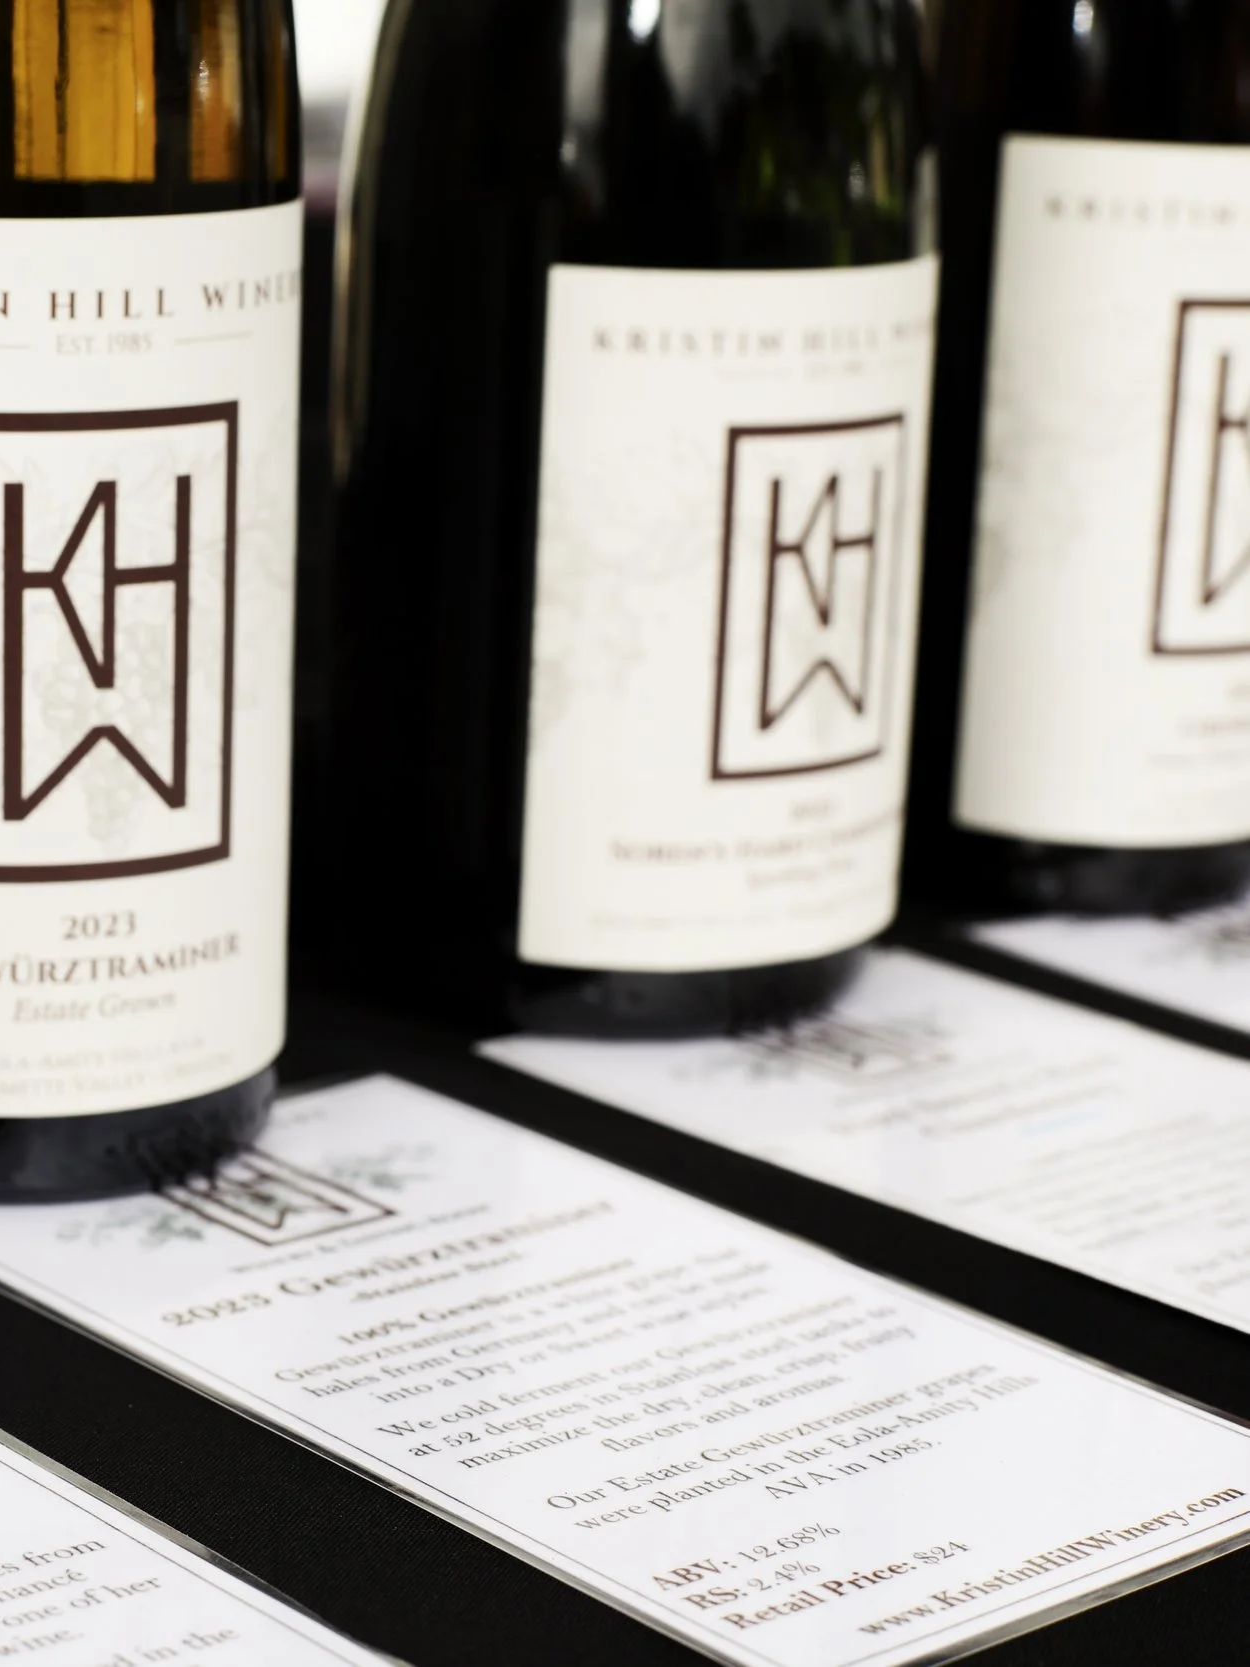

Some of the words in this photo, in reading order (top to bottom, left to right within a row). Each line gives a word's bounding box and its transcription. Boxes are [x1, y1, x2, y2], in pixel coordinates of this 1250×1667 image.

[49, 288, 173, 319] HILL
[107, 331, 153, 355] 1985
[61, 911, 137, 940] 2023
[12, 998, 89, 1024] Estate
[303, 1372, 381, 1398] hales
[381, 1354, 452, 1380] from
[369, 1382, 433, 1405] into
[454, 1360, 516, 1383] Dry
[375, 1418, 438, 1438] We
[441, 1400, 501, 1424] cold
[498, 1371, 607, 1407] ferment
[408, 1441, 442, 1458] at
[444, 1430, 481, 1449] 52
[484, 1401, 590, 1436] degrees
[585, 1390, 622, 1405] in
[601, 1419, 699, 1453] flavors
[700, 1401, 751, 1425] and
[456, 1427, 593, 1469] maximize
[592, 1409, 640, 1430] the
[642, 1394, 701, 1416] dry,
[547, 1487, 607, 1510] Our
[605, 1459, 703, 1492] Estate
[701, 1391, 912, 1463] Gewürztraminer
[574, 1504, 648, 1530] were
[648, 1468, 754, 1513] planted
[746, 1460, 786, 1476] in
[783, 1444, 833, 1465] the
[827, 1396, 981, 1449] Eola-Amity
[765, 1470, 837, 1499] AVA
[829, 1460, 868, 1475] in
[866, 1438, 942, 1465] 1985.
[22, 1537, 110, 1571] from
[652, 1558, 738, 1591] ABV:
[738, 1522, 841, 1563] 12.68%
[857, 1485, 1246, 1637] www.KristinHillWinery.com
[1, 1604, 64, 1628] one
[70, 1587, 104, 1610] of
[100, 1575, 163, 1599] her
[681, 1586, 748, 1610] RS:
[747, 1560, 821, 1592] 2.4%
[722, 1590, 828, 1630] Retail
[818, 1561, 917, 1596] Price:
[913, 1540, 971, 1566] $24
[181, 1626, 242, 1651] the
